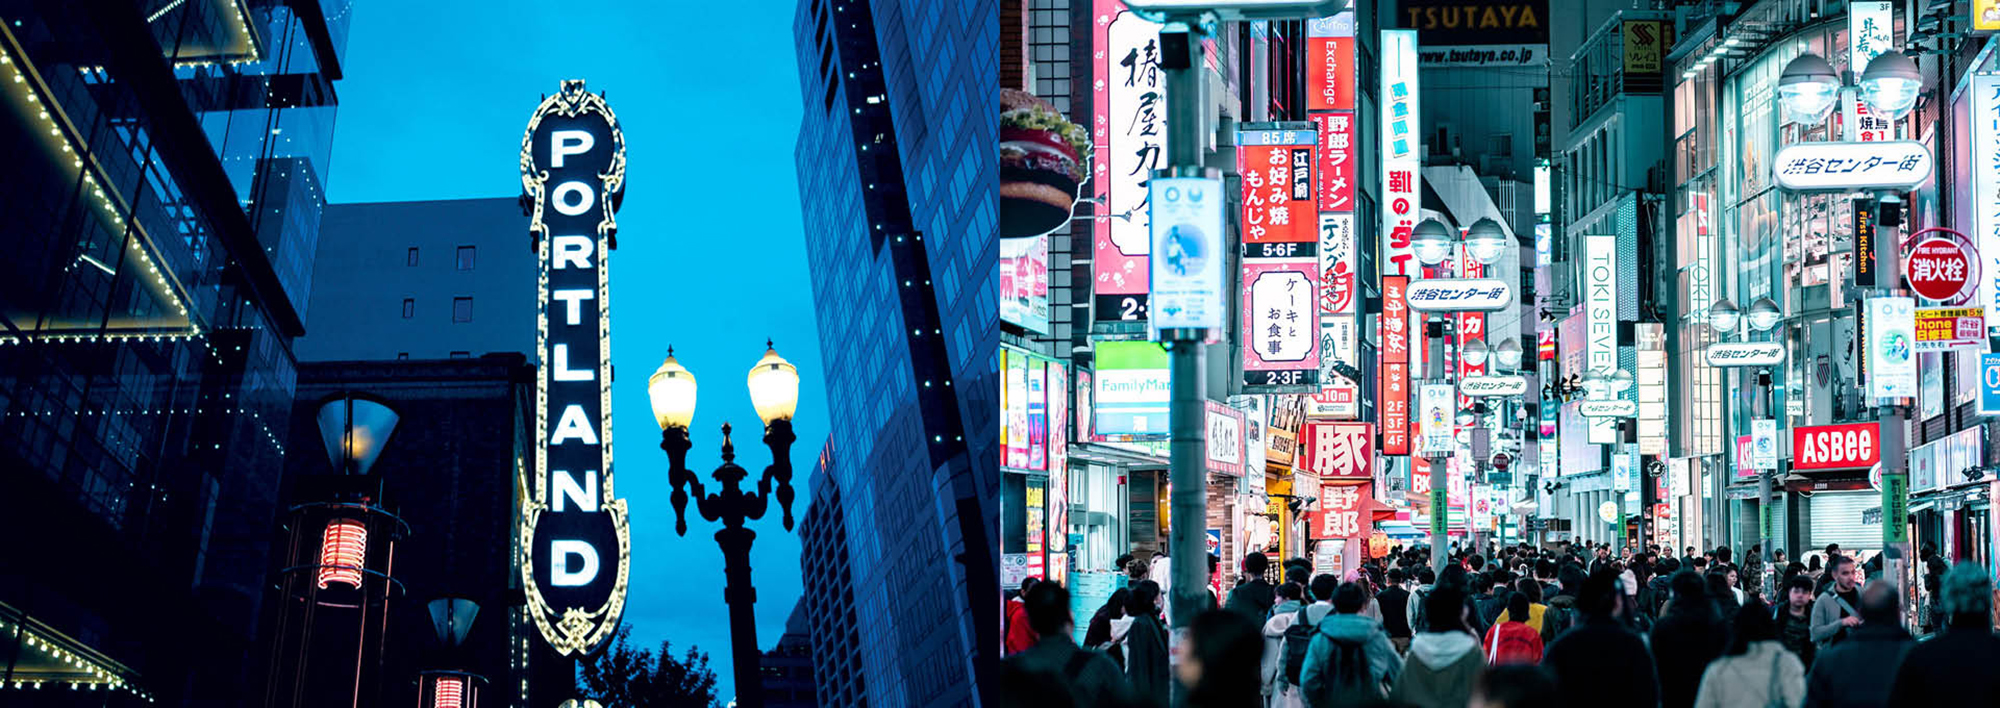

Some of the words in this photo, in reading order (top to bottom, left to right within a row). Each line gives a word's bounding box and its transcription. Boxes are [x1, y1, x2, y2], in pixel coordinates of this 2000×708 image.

[1407, 6, 1539, 30] TSUTAYA
[1323, 41, 1337, 105] Exchange
[1261, 132, 1296, 144] 85席
[1327, 116, 1349, 209] 野郎ラーメン
[1783, 155, 1923, 175] 渋谷センター街
[1246, 170, 1266, 240] もんじゃ
[1268, 147, 1289, 226] お好み焼
[1859, 211, 1868, 234] First
[1322, 218, 1345, 272] テング
[1859, 236, 1868, 273] Kitchen
[1917, 246, 1930, 255] FIRE
[1592, 252, 1610, 302] TOKI
[1912, 257, 1965, 282] 消火栓
[1286, 278, 1299, 338] ケーキと
[1410, 286, 1505, 301] 渋谷センター街
[1267, 307, 1282, 355] お食事
[550, 130, 600, 587] PORTLAND
[1711, 348, 1779, 360] 渋谷センター街
[1387, 400, 1404, 412] 2F
[1387, 417, 1404, 430] 3F
[1313, 424, 1367, 476] 豚
[1387, 435, 1404, 447] 4F
[1322, 485, 1359, 537] 野郎
